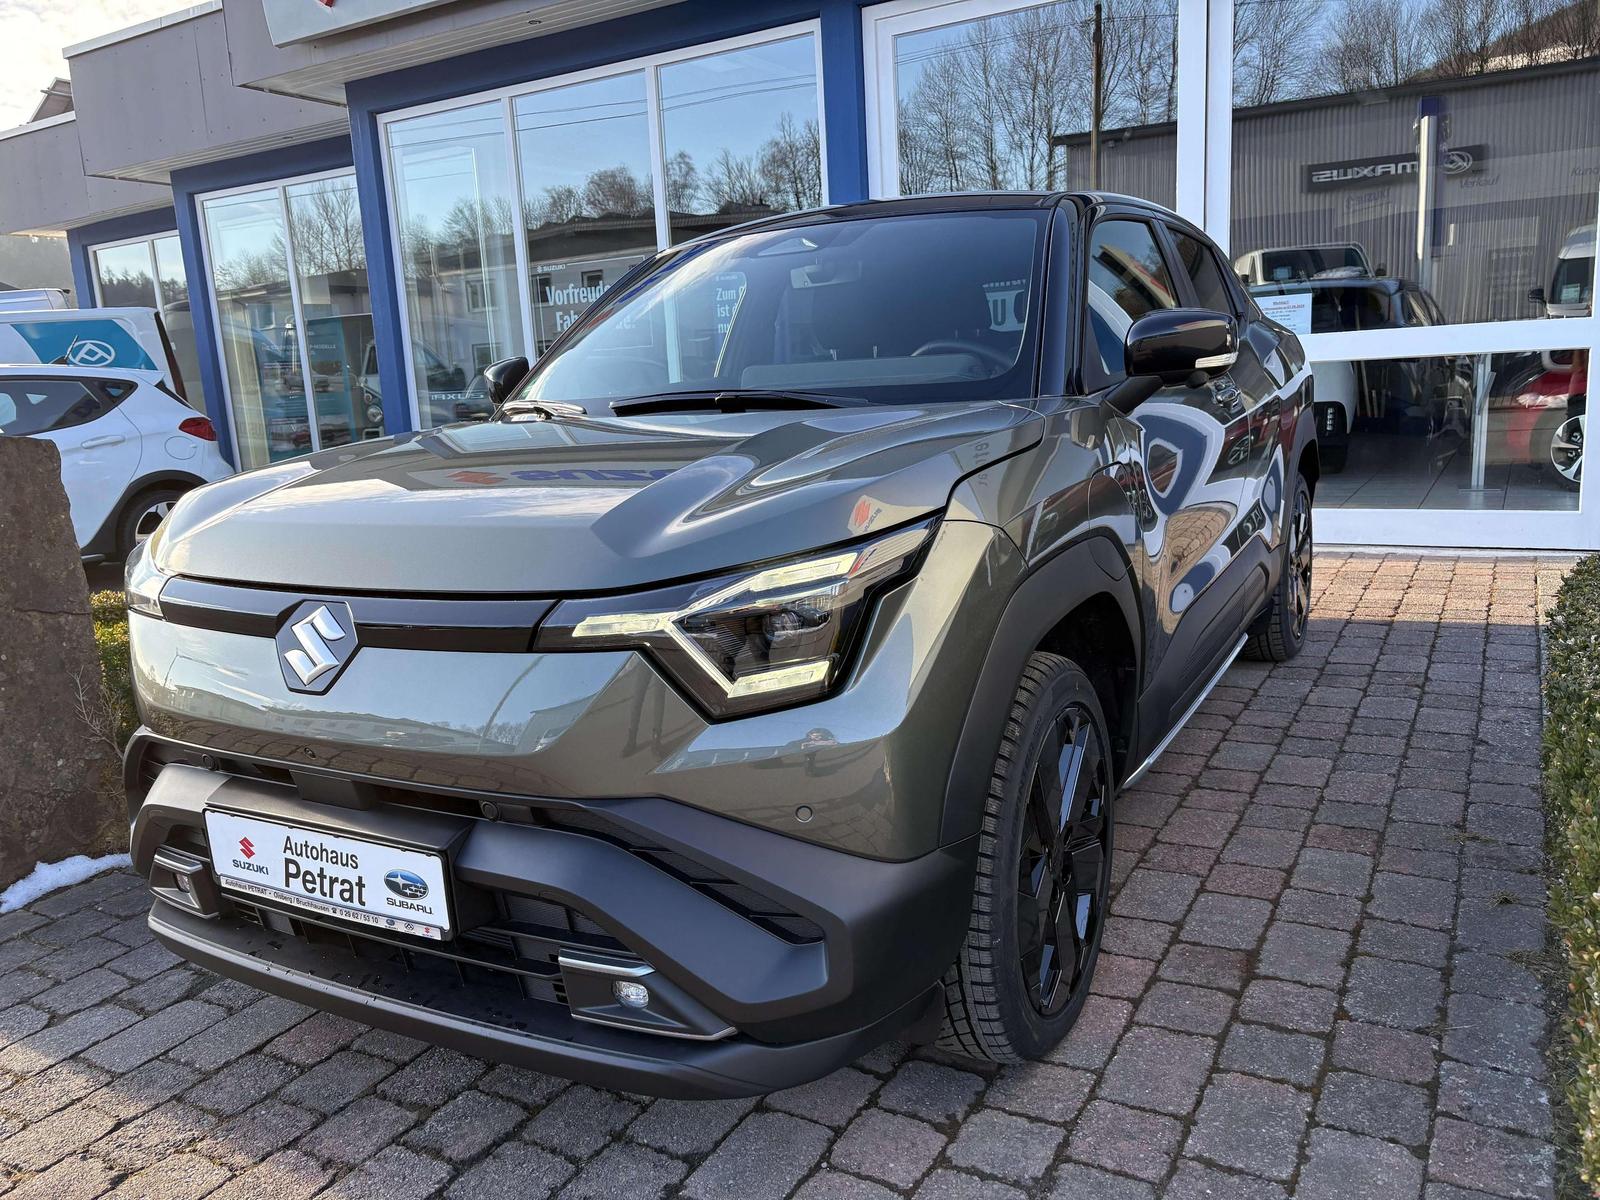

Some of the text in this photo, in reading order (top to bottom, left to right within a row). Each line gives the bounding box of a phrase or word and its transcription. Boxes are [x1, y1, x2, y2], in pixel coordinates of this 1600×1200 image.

[543, 264, 566, 272] SUZUKI
[716, 287, 736, 301] Zum
[717, 303, 730, 318] ist
[283, 835, 359, 870] Autohaus
[232, 859, 269, 876] SUZUKI
[284, 857, 366, 906] Petrat
[247, 884, 267, 896] PETRAT
[386, 897, 433, 915] SUBARU
